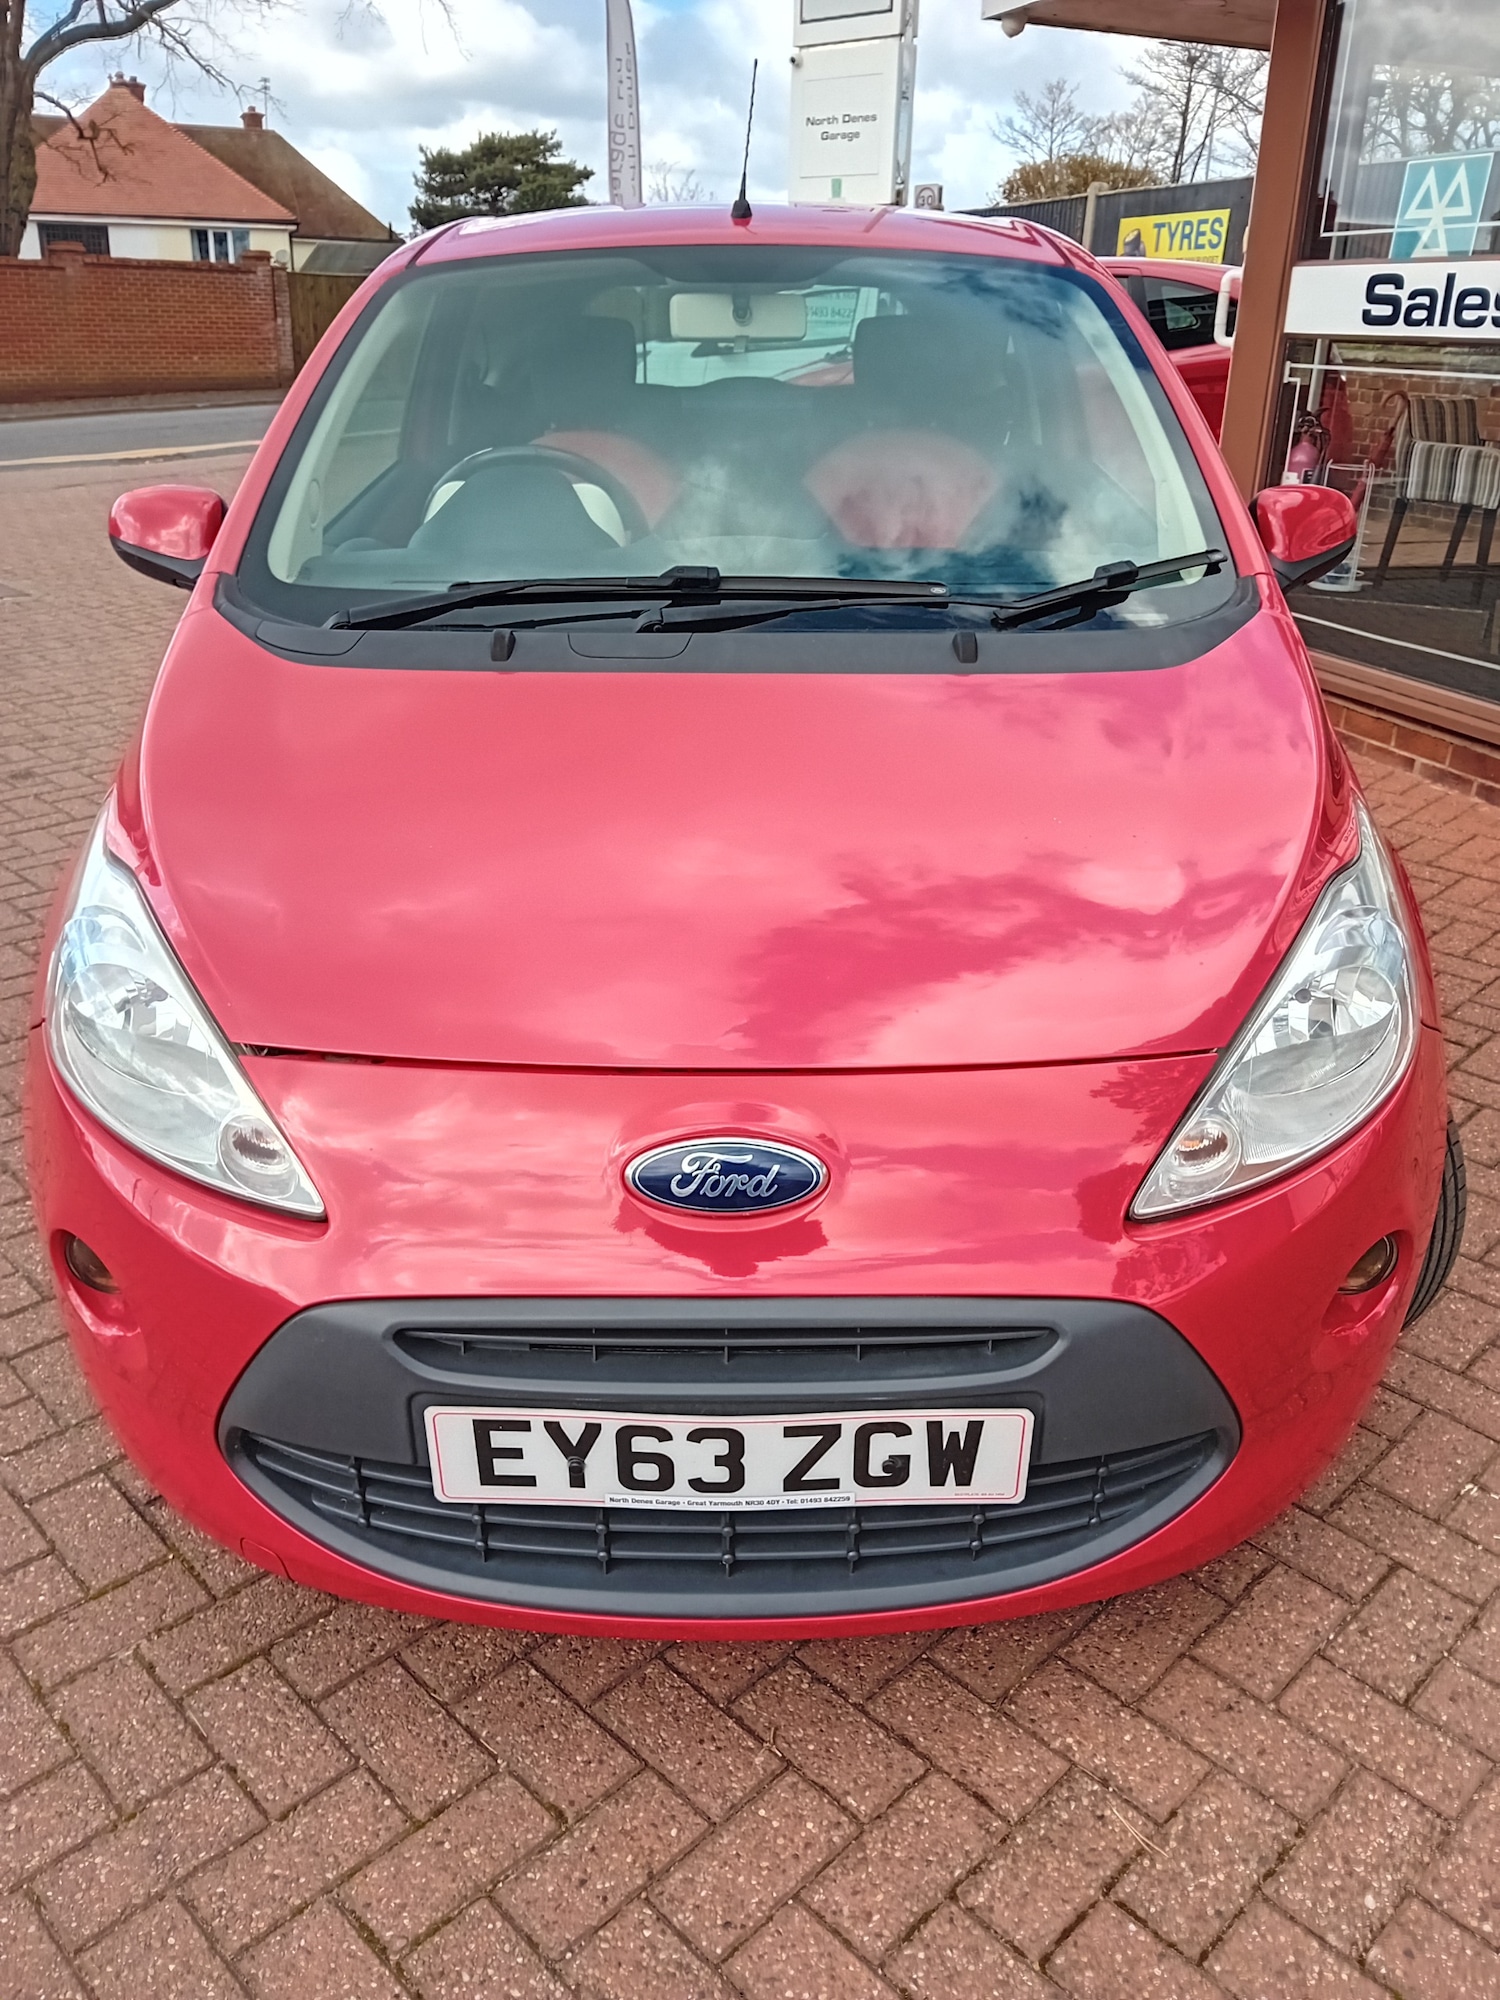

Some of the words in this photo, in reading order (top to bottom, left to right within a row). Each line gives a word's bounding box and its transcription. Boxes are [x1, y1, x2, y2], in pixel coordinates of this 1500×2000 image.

[805, 115, 839, 127] North
[842, 114, 877, 123] Denes
[821, 131, 860, 141] Garage
[1153, 216, 1224, 253] TYRES
[670, 1151, 781, 1198] Ford
[472, 1418, 745, 1493] EY63
[782, 1420, 985, 1493] ZGW
[655, 1498, 681, 1506] Garage
